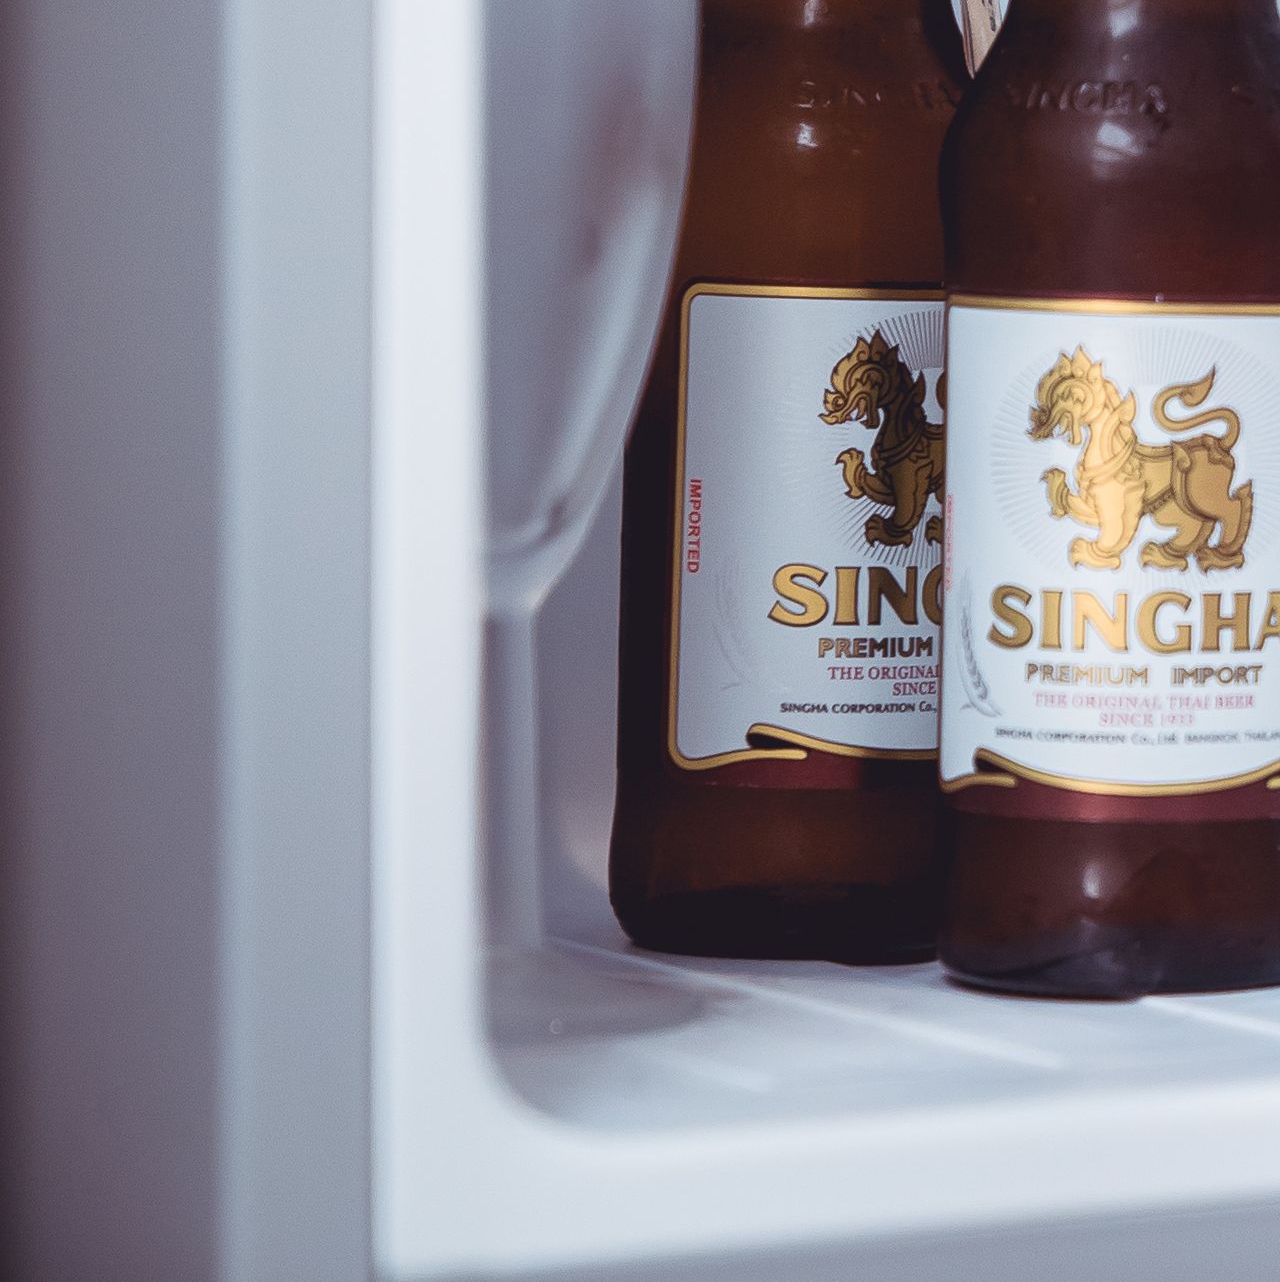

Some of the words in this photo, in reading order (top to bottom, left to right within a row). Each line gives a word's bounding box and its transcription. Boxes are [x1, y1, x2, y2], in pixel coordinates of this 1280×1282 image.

[687, 478, 702, 573] IMPORTED
[818, 637, 933, 659] PREMIUM
[828, 666, 864, 681] THE
[1025, 663, 1150, 687] PREMIUM
[1171, 664, 1264, 687] IMPORT
[892, 681, 937, 696] SINCE
[780, 701, 828, 713] SINGHA
[832, 702, 915, 714] CORPORATION
[1034, 692, 1067, 709] THE
[1072, 694, 1162, 710] ORIGINAL
